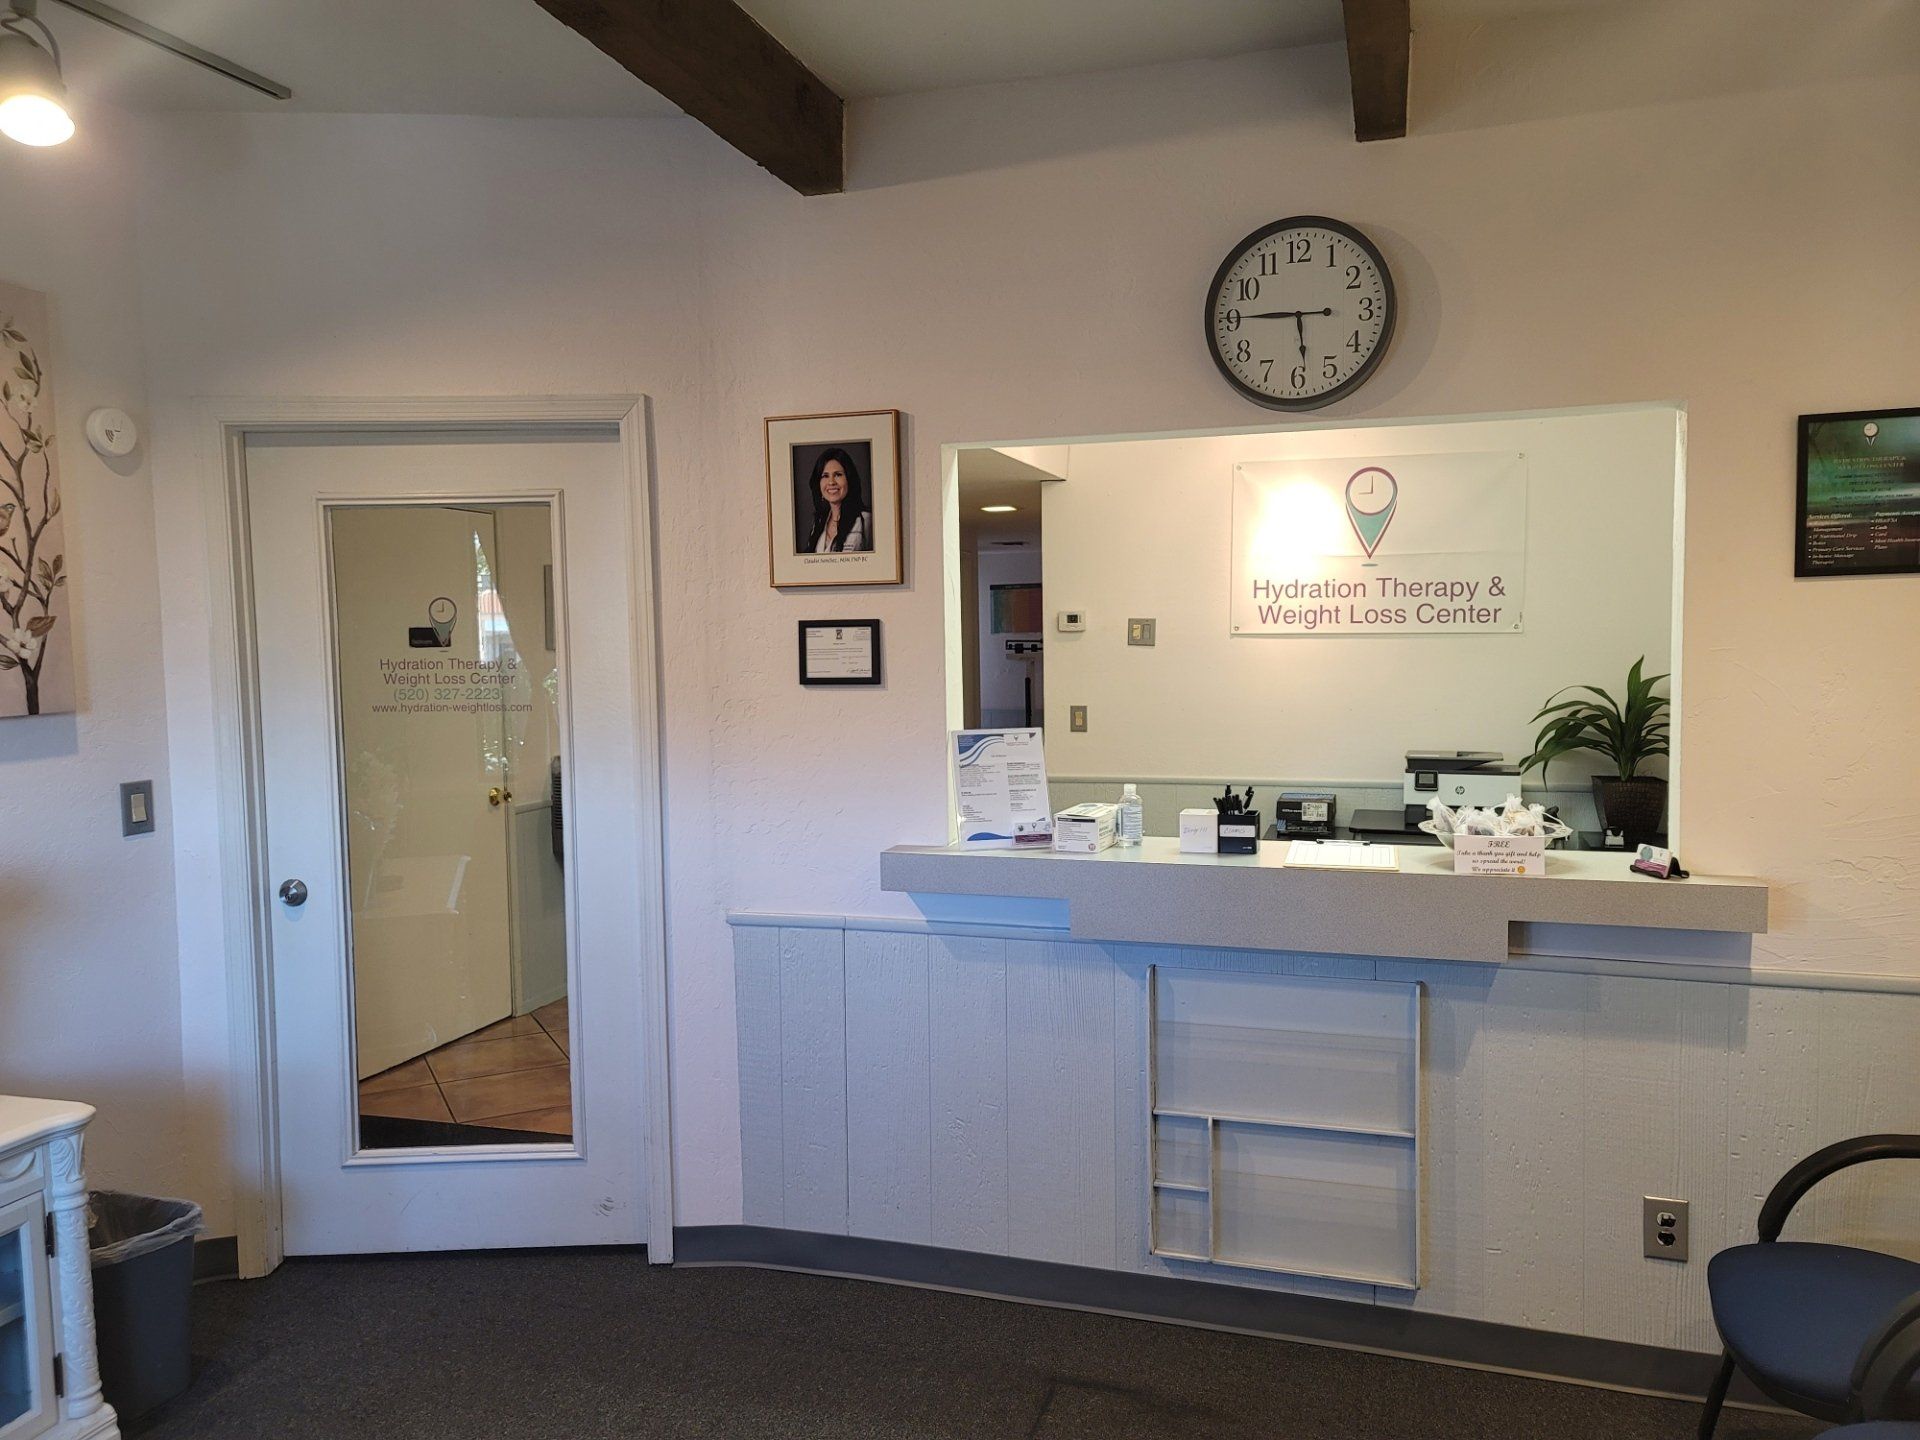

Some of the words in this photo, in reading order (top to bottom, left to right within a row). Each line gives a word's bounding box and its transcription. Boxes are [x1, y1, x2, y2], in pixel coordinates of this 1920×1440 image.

[1286, 238, 1312, 264] 12
[1326, 244, 1337, 268] 1
[1258, 252, 1279, 277] 11
[1237, 277, 1260, 302] 10
[1345, 265, 1361, 290] 2
[1226, 309, 1241, 332] 9
[1358, 297, 1374, 321] 3
[1236, 339, 1251, 363] 8
[1346, 330, 1362, 353] 4
[1259, 359, 1275, 384] 7
[1290, 366, 1306, 389] 6
[1322, 355, 1337, 379] 5
[1253, 578, 1367, 603] Hydration
[1375, 577, 1480, 602] Therapy
[1488, 575, 1506, 597] &
[1258, 604, 1341, 630] Weight
[1350, 605, 1407, 624] Loss
[1416, 603, 1502, 624] Center
[380, 658, 443, 672] Hydration
[448, 658, 502, 673] Therapy
[507, 658, 517, 670] &
[383, 673, 430, 687] Weight
[435, 673, 466, 685] Loss
[470, 673, 515, 685] Center
[394, 688, 430, 703] (520)
[434, 688, 500, 701] 327-2223
[372, 703, 532, 714] www.hydration-weightloss.com
[1488, 840, 1510, 848] FREE
